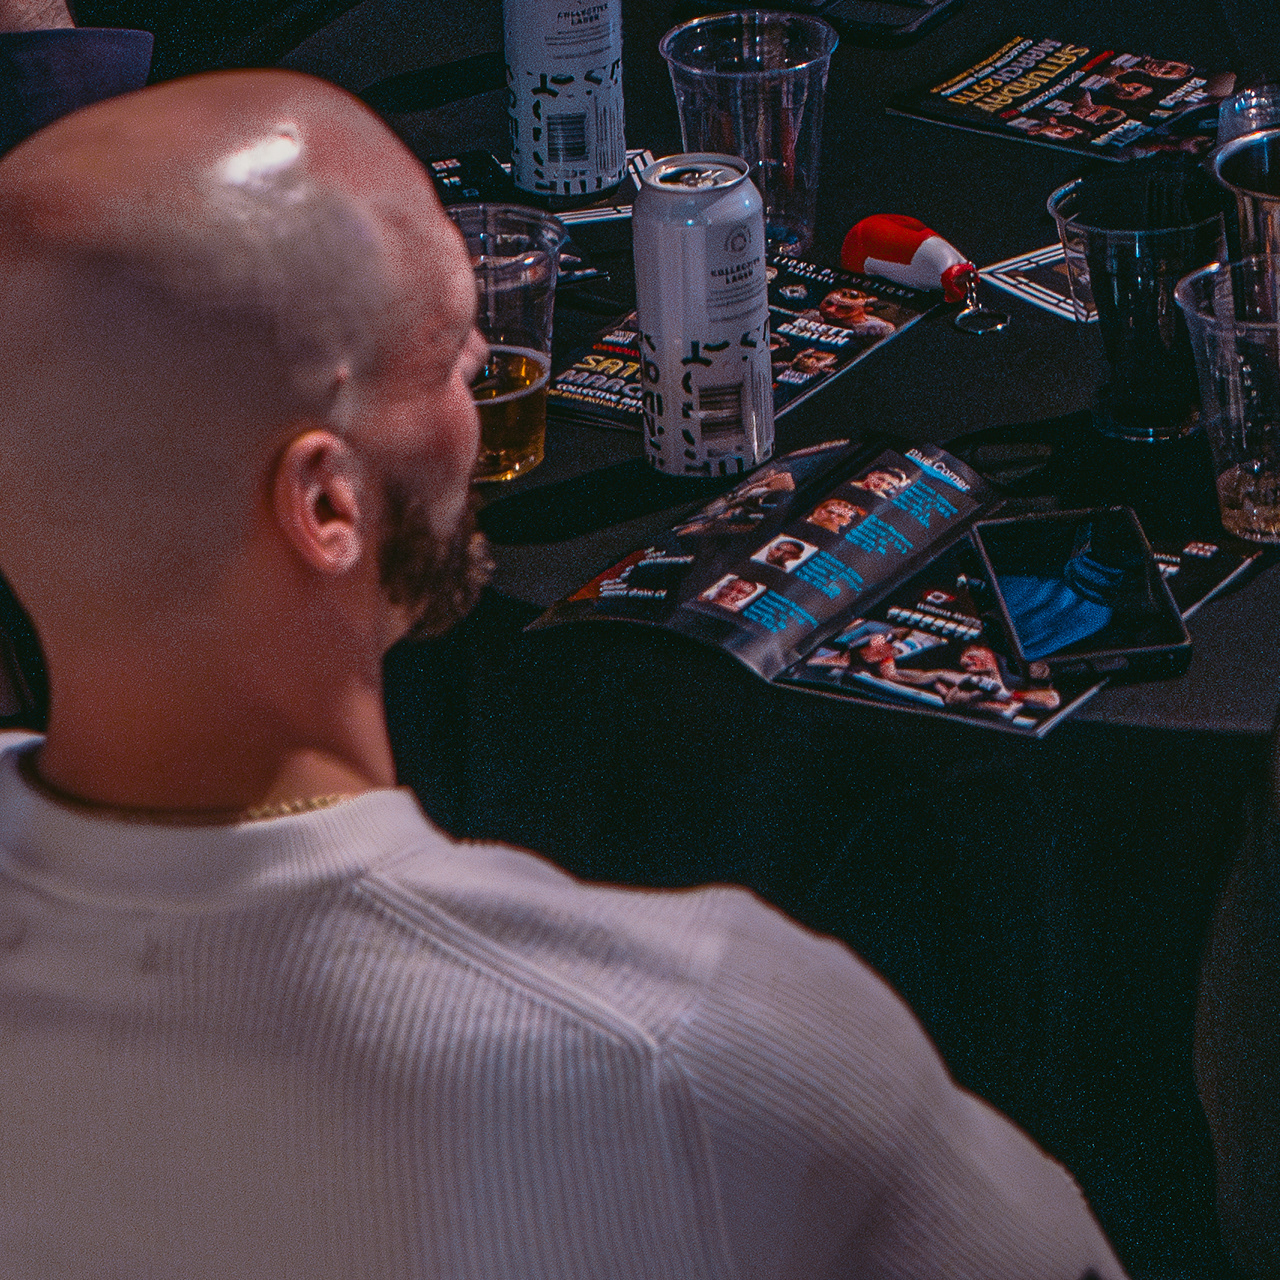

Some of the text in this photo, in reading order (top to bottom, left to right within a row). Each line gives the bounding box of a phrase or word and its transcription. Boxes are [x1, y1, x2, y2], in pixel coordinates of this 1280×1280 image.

[572, 354, 642, 380] SAT
[555, 369, 643, 399] MARC
[904, 447, 972, 492] Blue Corner
